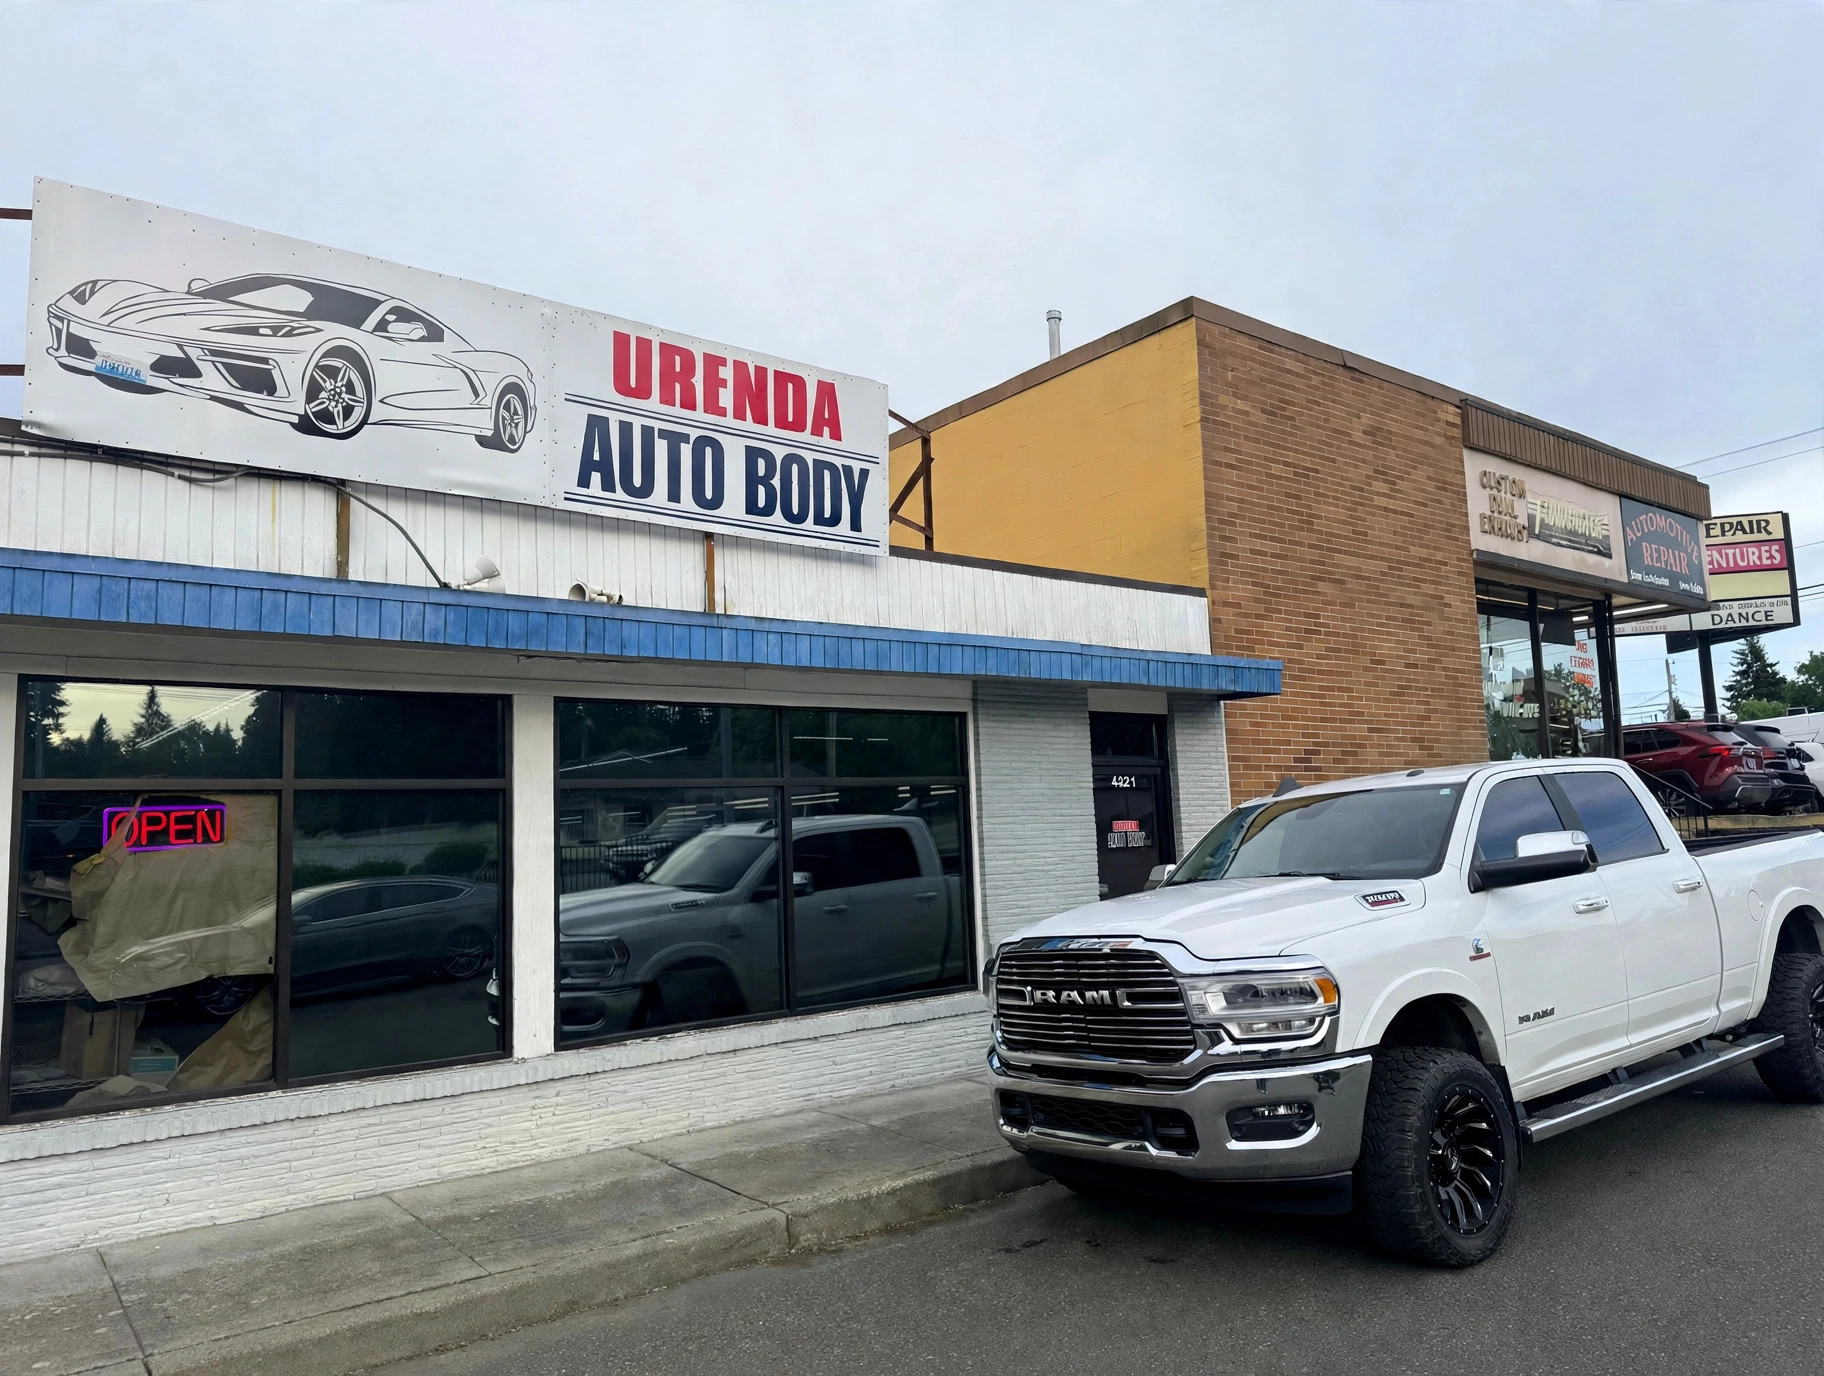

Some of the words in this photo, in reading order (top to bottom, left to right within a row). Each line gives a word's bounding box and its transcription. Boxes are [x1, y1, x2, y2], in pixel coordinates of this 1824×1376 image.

[613, 330, 842, 442] URENDA
[577, 413, 725, 510] AUTO
[744, 445, 870, 533] BODY
[1479, 469, 1527, 499] CUSTOM
[1625, 512, 1699, 564] AUTOMOTIVE
[1705, 519, 1773, 538] EPAIR
[1641, 542, 1690, 575] REPAIR
[1711, 610, 1775, 626] DANCE
[111, 809, 221, 849] OPEN
[1033, 989, 1113, 1005] RAM
